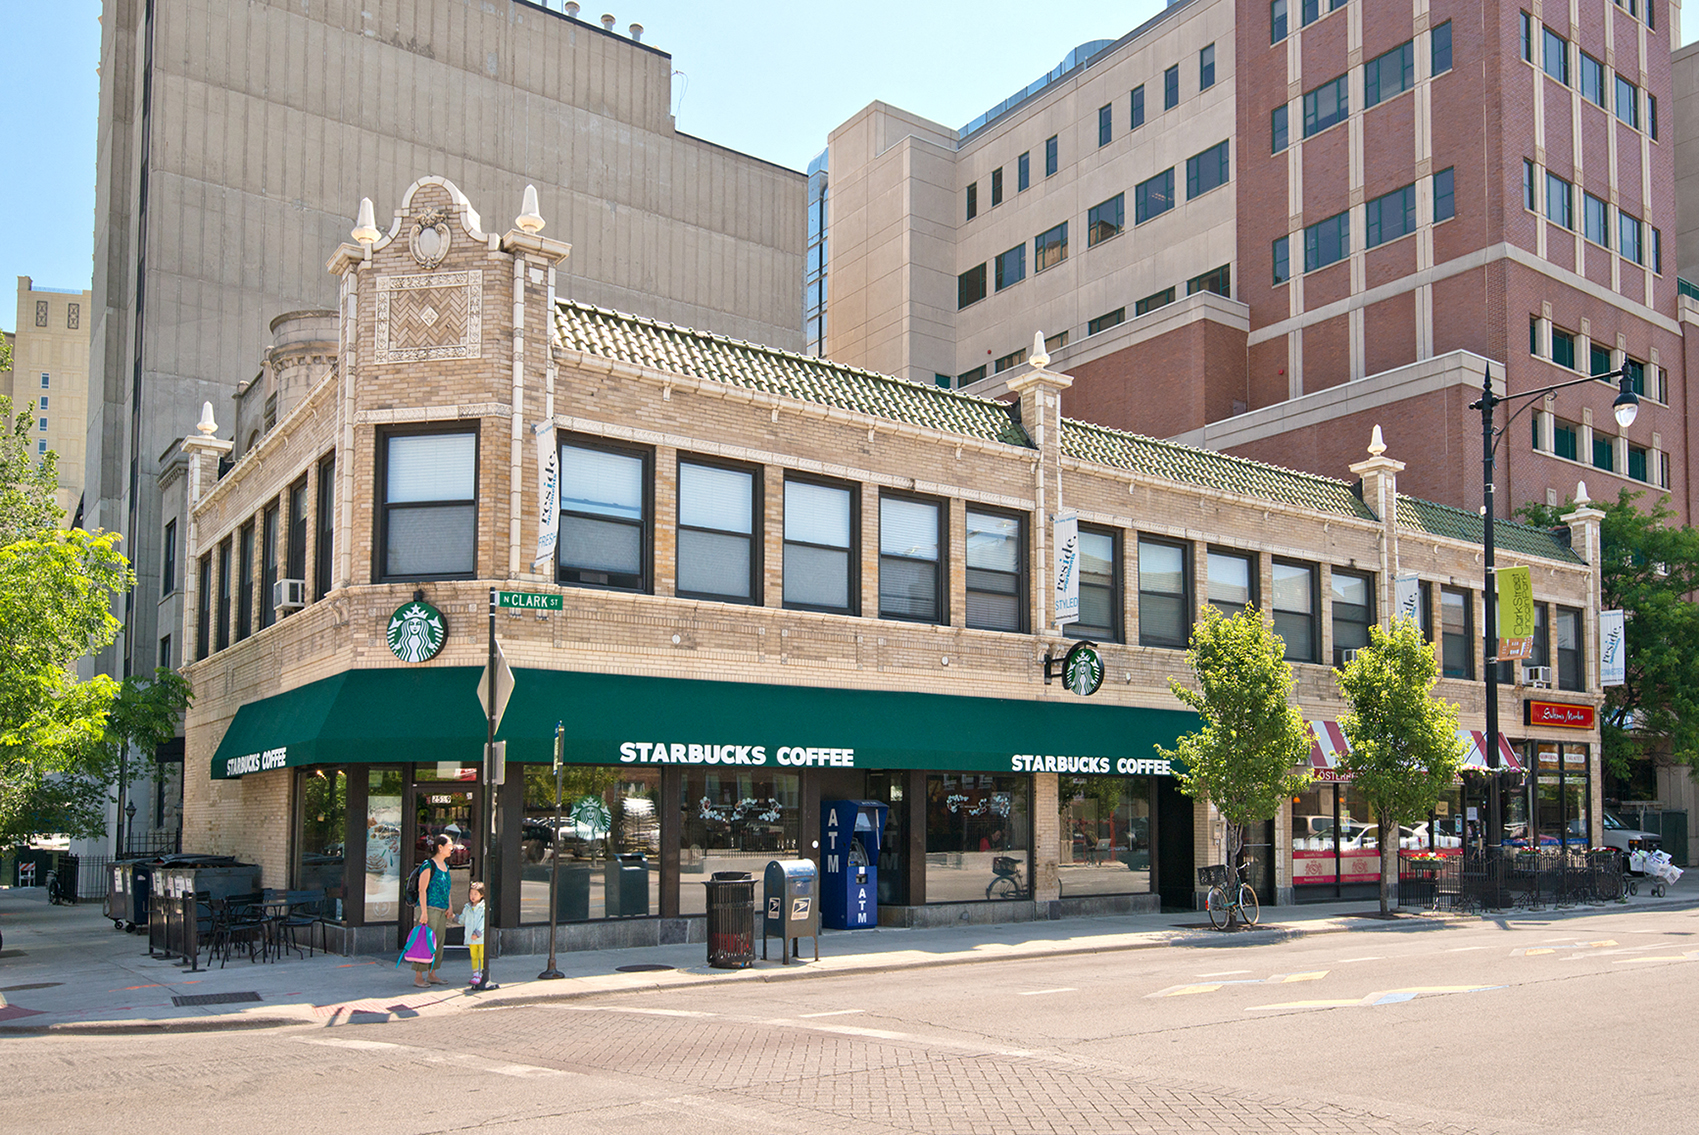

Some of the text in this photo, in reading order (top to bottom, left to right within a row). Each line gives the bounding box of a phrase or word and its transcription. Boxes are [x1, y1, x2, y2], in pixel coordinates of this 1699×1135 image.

[1056, 535, 1077, 591] reside.
[503, 593, 559, 608] N CLARK ST
[1055, 596, 1079, 611] STYLED
[226, 746, 287, 776] STARBUCKS COFFEE
[619, 742, 854, 767] STARBUCKS COFFEE
[1011, 754, 1171, 775] STARBUCKS COFFEE
[827, 808, 840, 873] ATM
[857, 887, 867, 924] ATM
